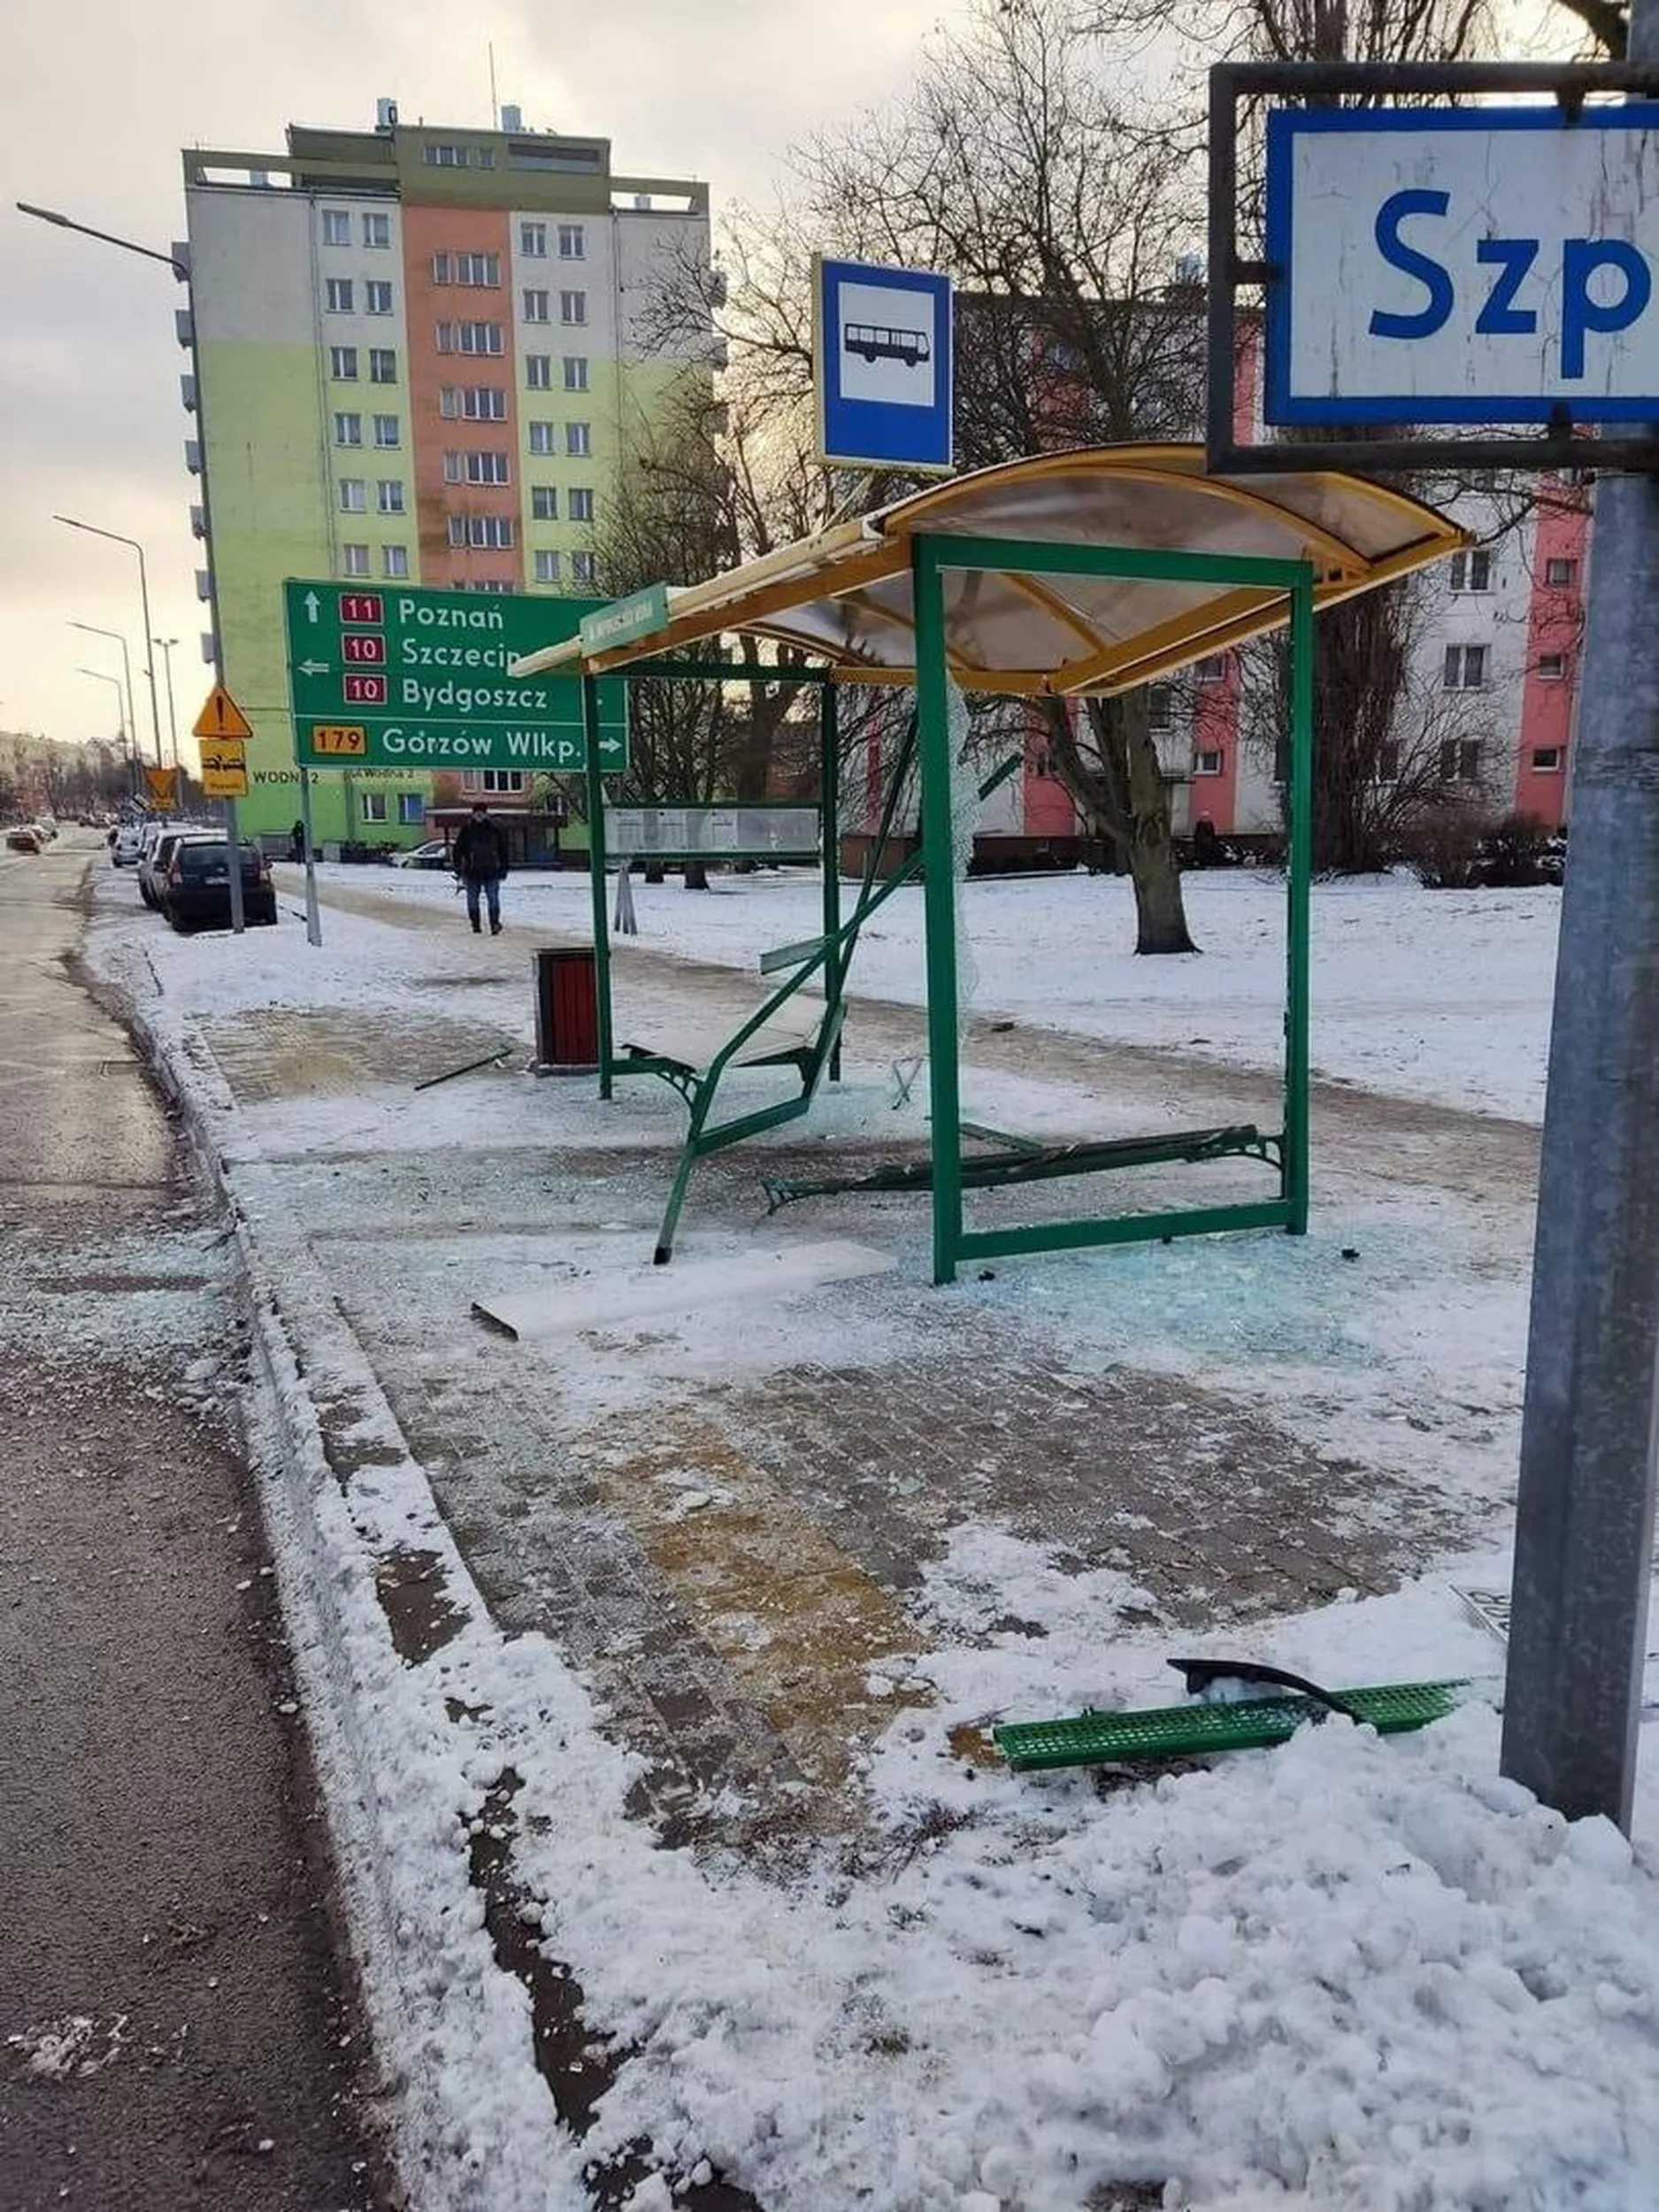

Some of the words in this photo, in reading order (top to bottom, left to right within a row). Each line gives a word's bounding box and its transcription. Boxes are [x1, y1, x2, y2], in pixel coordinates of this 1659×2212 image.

[348, 597, 373, 619] 11
[400, 599, 503, 629] Poznań
[350, 638, 377, 659] 10
[352, 679, 379, 699] 10
[403, 678, 547, 712] Bydgoszcz
[317, 731, 361, 750] 179
[507, 731, 582, 763] Wlkp.
[252, 771, 302, 785] WODN
[311, 772, 319, 784] 2
